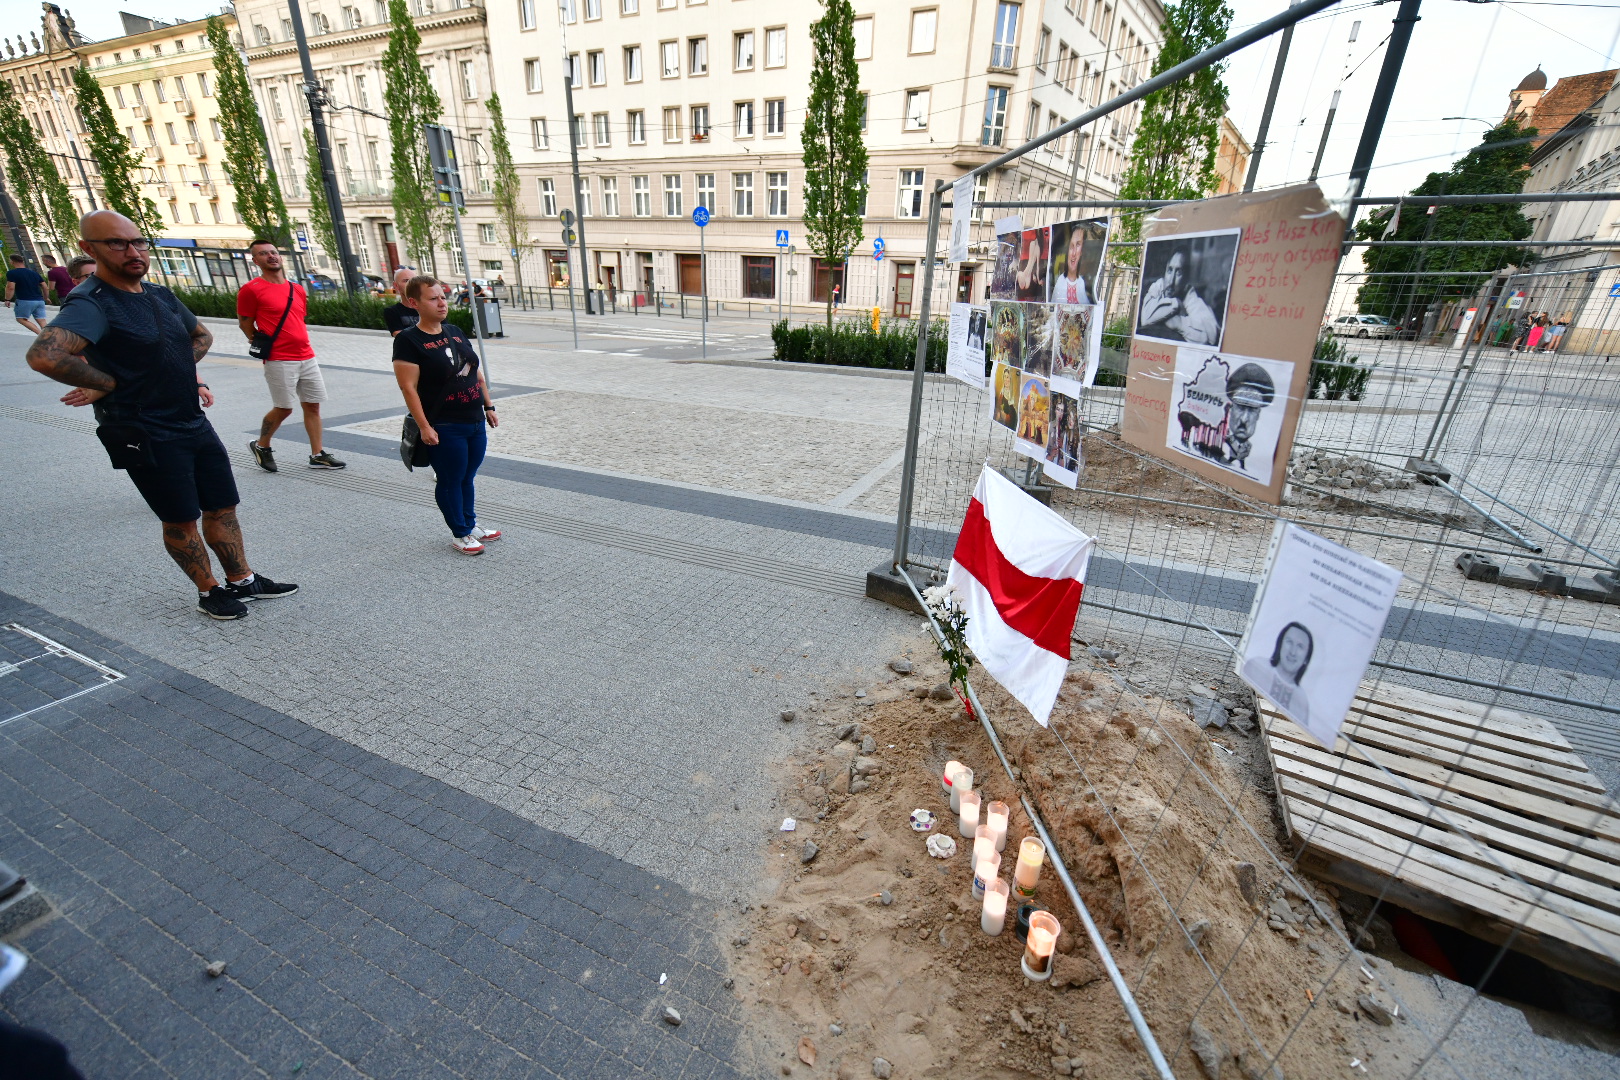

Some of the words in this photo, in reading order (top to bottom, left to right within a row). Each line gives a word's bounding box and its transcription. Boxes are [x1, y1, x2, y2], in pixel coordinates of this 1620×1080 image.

[1245, 270, 1301, 292] zabity
[1257, 293, 1267, 304] w
[1229, 301, 1305, 320] więzieniu
[1187, 389, 1224, 407] БЕЛАРУСЬ
